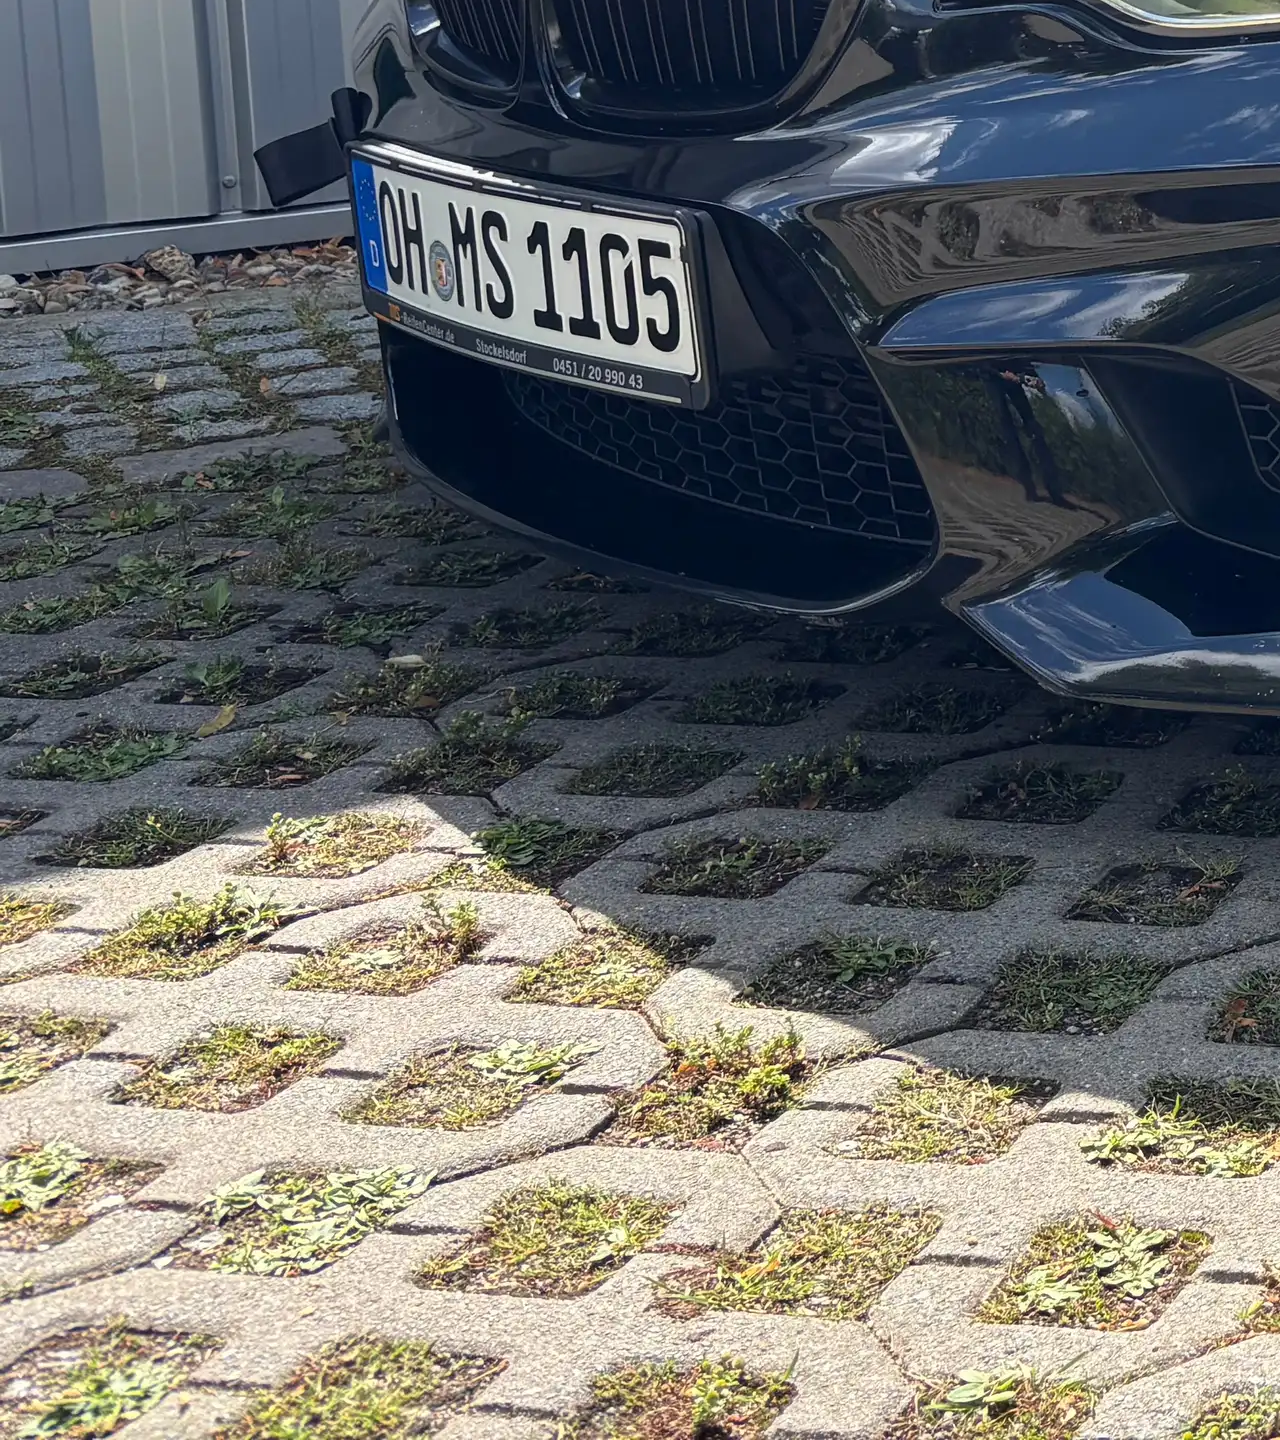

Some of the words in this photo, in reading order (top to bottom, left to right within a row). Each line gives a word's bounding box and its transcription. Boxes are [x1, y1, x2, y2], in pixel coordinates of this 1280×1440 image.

[369, 239, 379, 267] D
[379, 180, 429, 296] OH
[448, 201, 514, 320] MS
[527, 220, 682, 353] 1105
[476, 338, 527, 364] Stockelsdorf
[553, 357, 578, 376] 0451
[588, 365, 602, 381] 20
[604, 368, 626, 386] 990
[628, 373, 644, 390] 43
